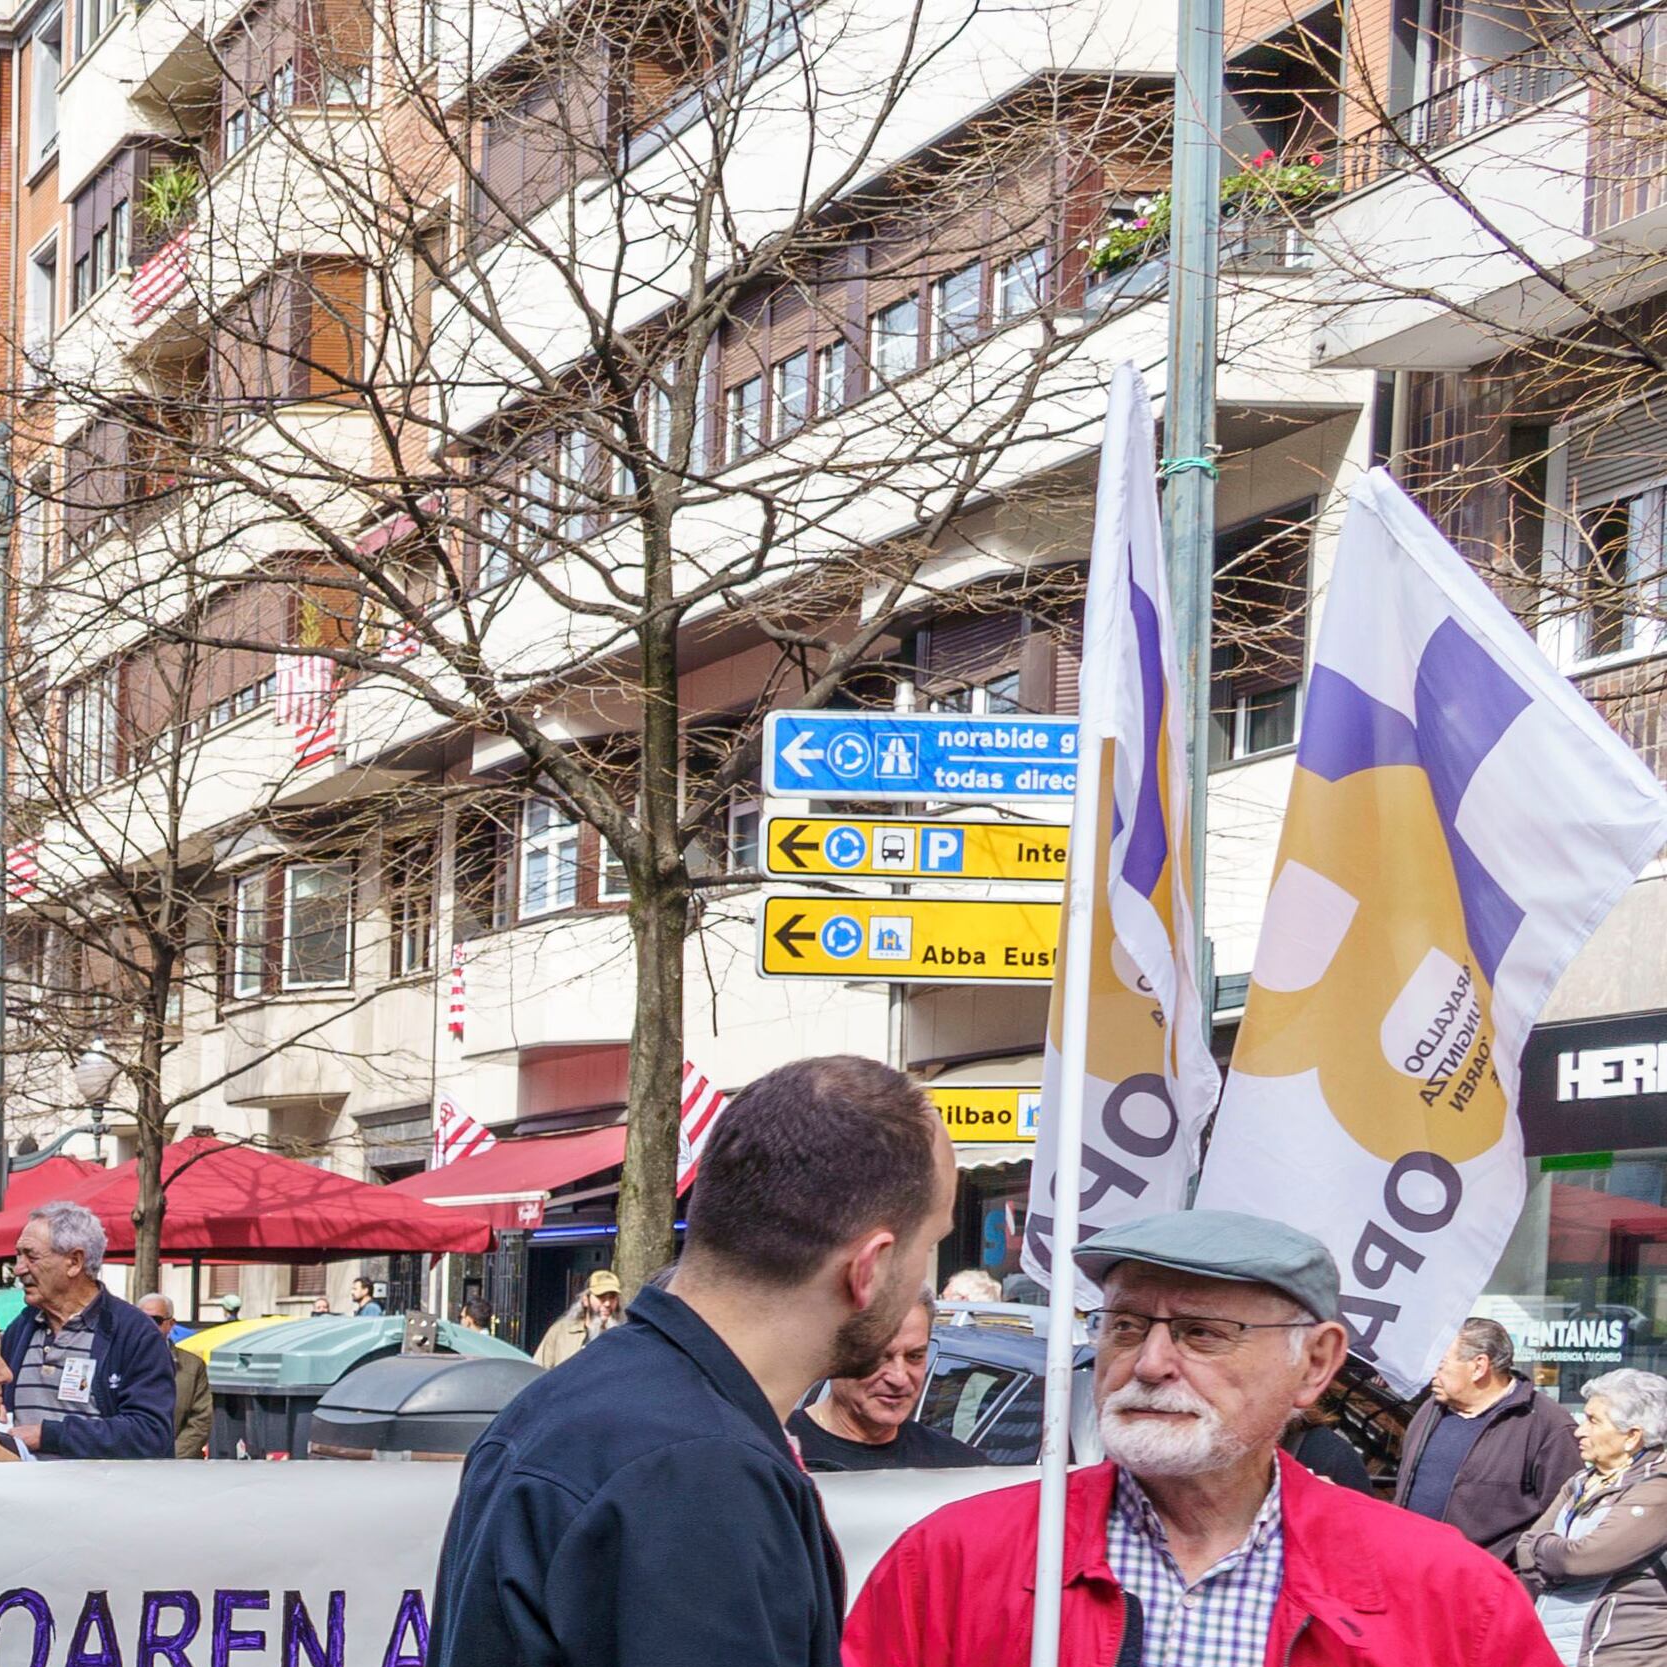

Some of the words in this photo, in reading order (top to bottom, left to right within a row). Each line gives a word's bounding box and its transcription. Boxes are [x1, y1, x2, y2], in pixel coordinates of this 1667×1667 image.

[937, 727, 1049, 749] norabide
[934, 768, 1004, 789] todas
[1015, 769, 1076, 792] direc
[928, 832, 957, 869] P
[1017, 843, 1067, 863] Inte
[922, 945, 986, 966] Abba
[1556, 1041, 1667, 1102] HER
[1520, 1319, 1624, 1348] VENTANAS
